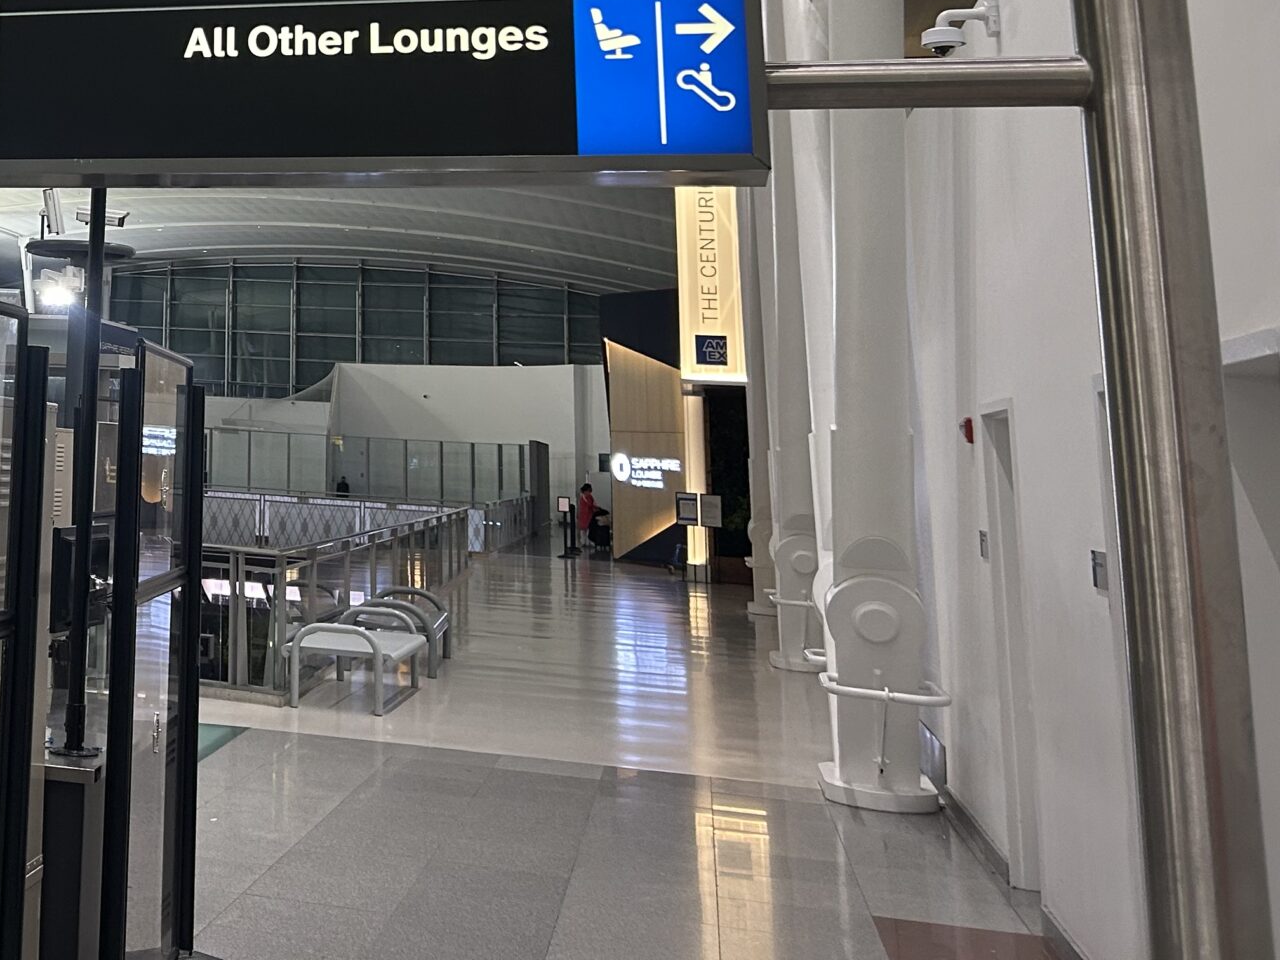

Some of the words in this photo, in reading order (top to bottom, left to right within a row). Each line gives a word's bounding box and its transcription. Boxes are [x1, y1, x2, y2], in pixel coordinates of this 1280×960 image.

[183, 26, 239, 59] All
[247, 24, 360, 58] Other
[369, 22, 549, 60] Lounges
[698, 187, 717, 278] CENTURI
[701, 285, 719, 324] THE
[703, 339, 727, 351] AM
[706, 351, 727, 362] EX
